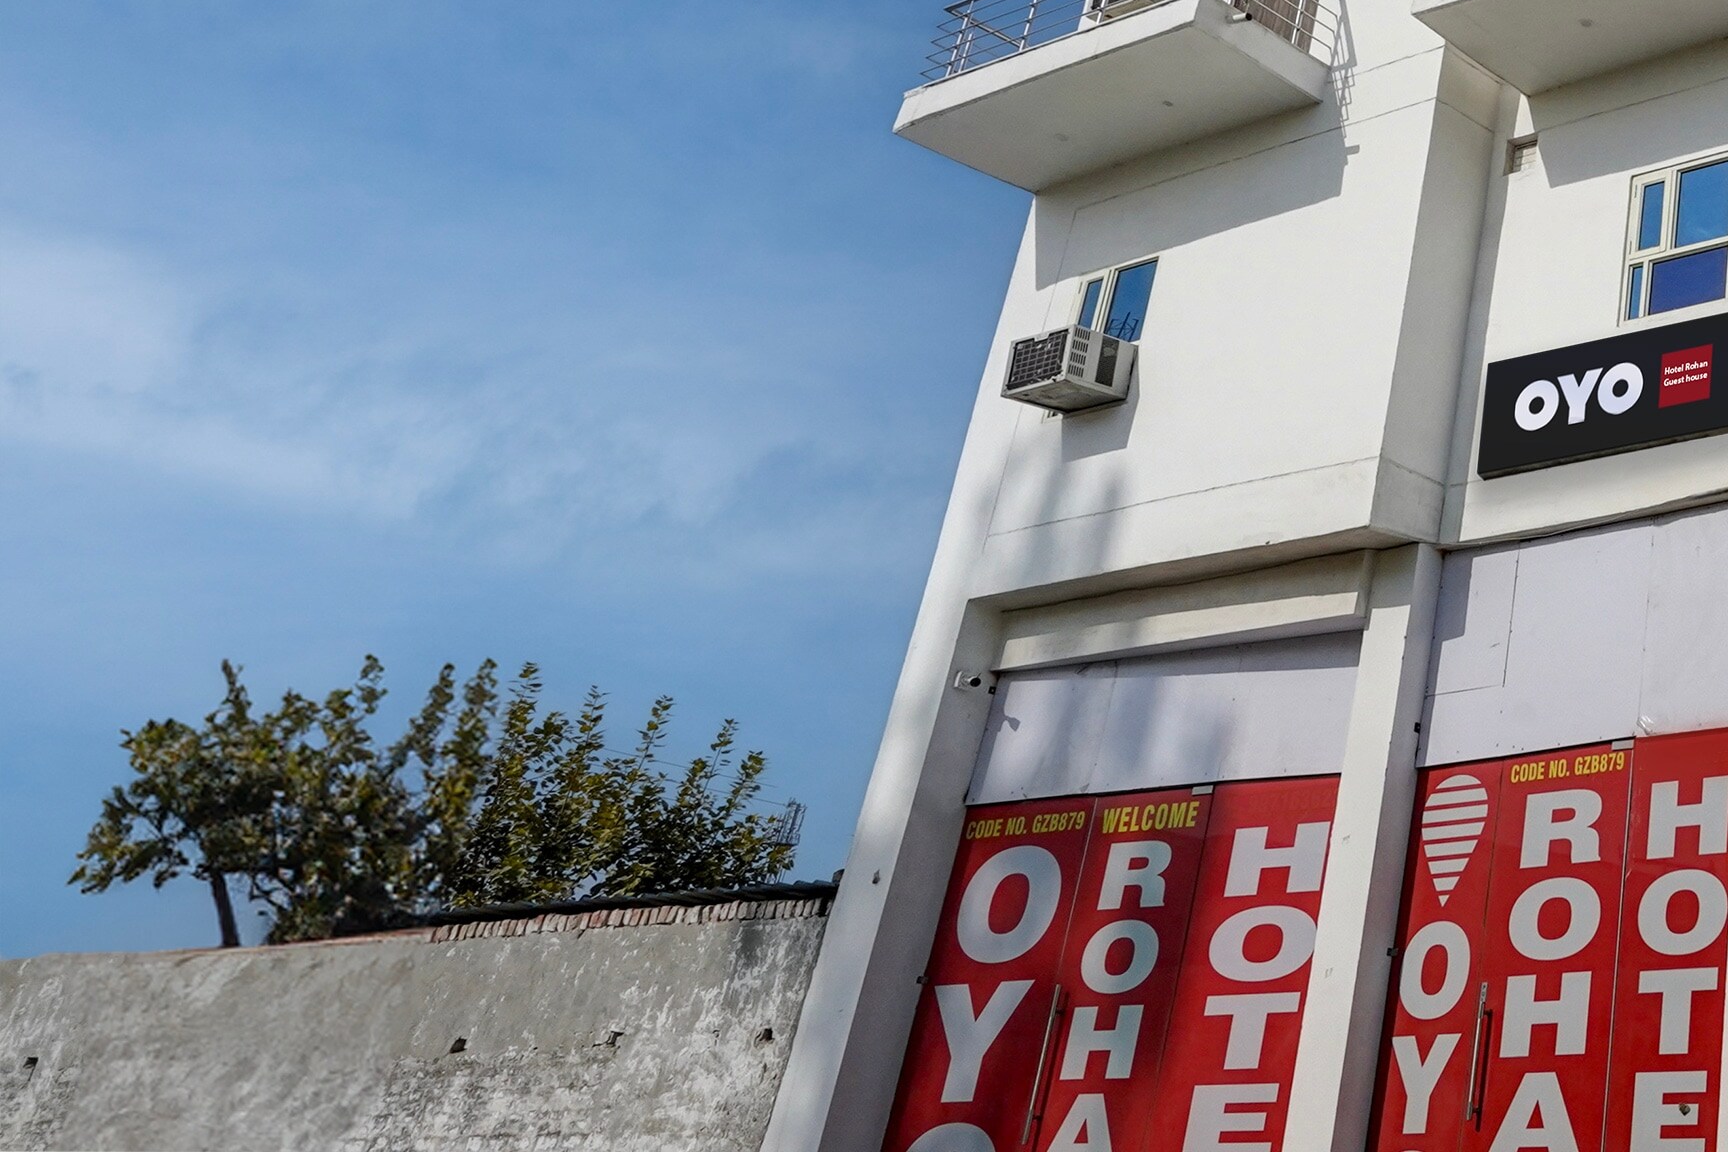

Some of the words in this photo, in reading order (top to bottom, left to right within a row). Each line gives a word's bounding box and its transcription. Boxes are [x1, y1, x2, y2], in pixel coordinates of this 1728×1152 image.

[1663, 376, 1684, 387] Guest
[1685, 373, 1708, 382] house
[1664, 364, 1684, 375] Hotel
[1685, 361, 1708, 371] Rohan
[1514, 362, 1643, 431] OYO
[1510, 762, 1544, 784] CODE
[1549, 759, 1570, 779] NO.
[1574, 751, 1625, 777] GZB879
[966, 817, 1002, 840] CODE
[1005, 817, 1027, 836] NO.
[1032, 811, 1086, 834] GZB879
[1102, 801, 1200, 834] WELCOME
[905, 845, 1062, 1152] OY
[1392, 920, 1471, 1152] OY
